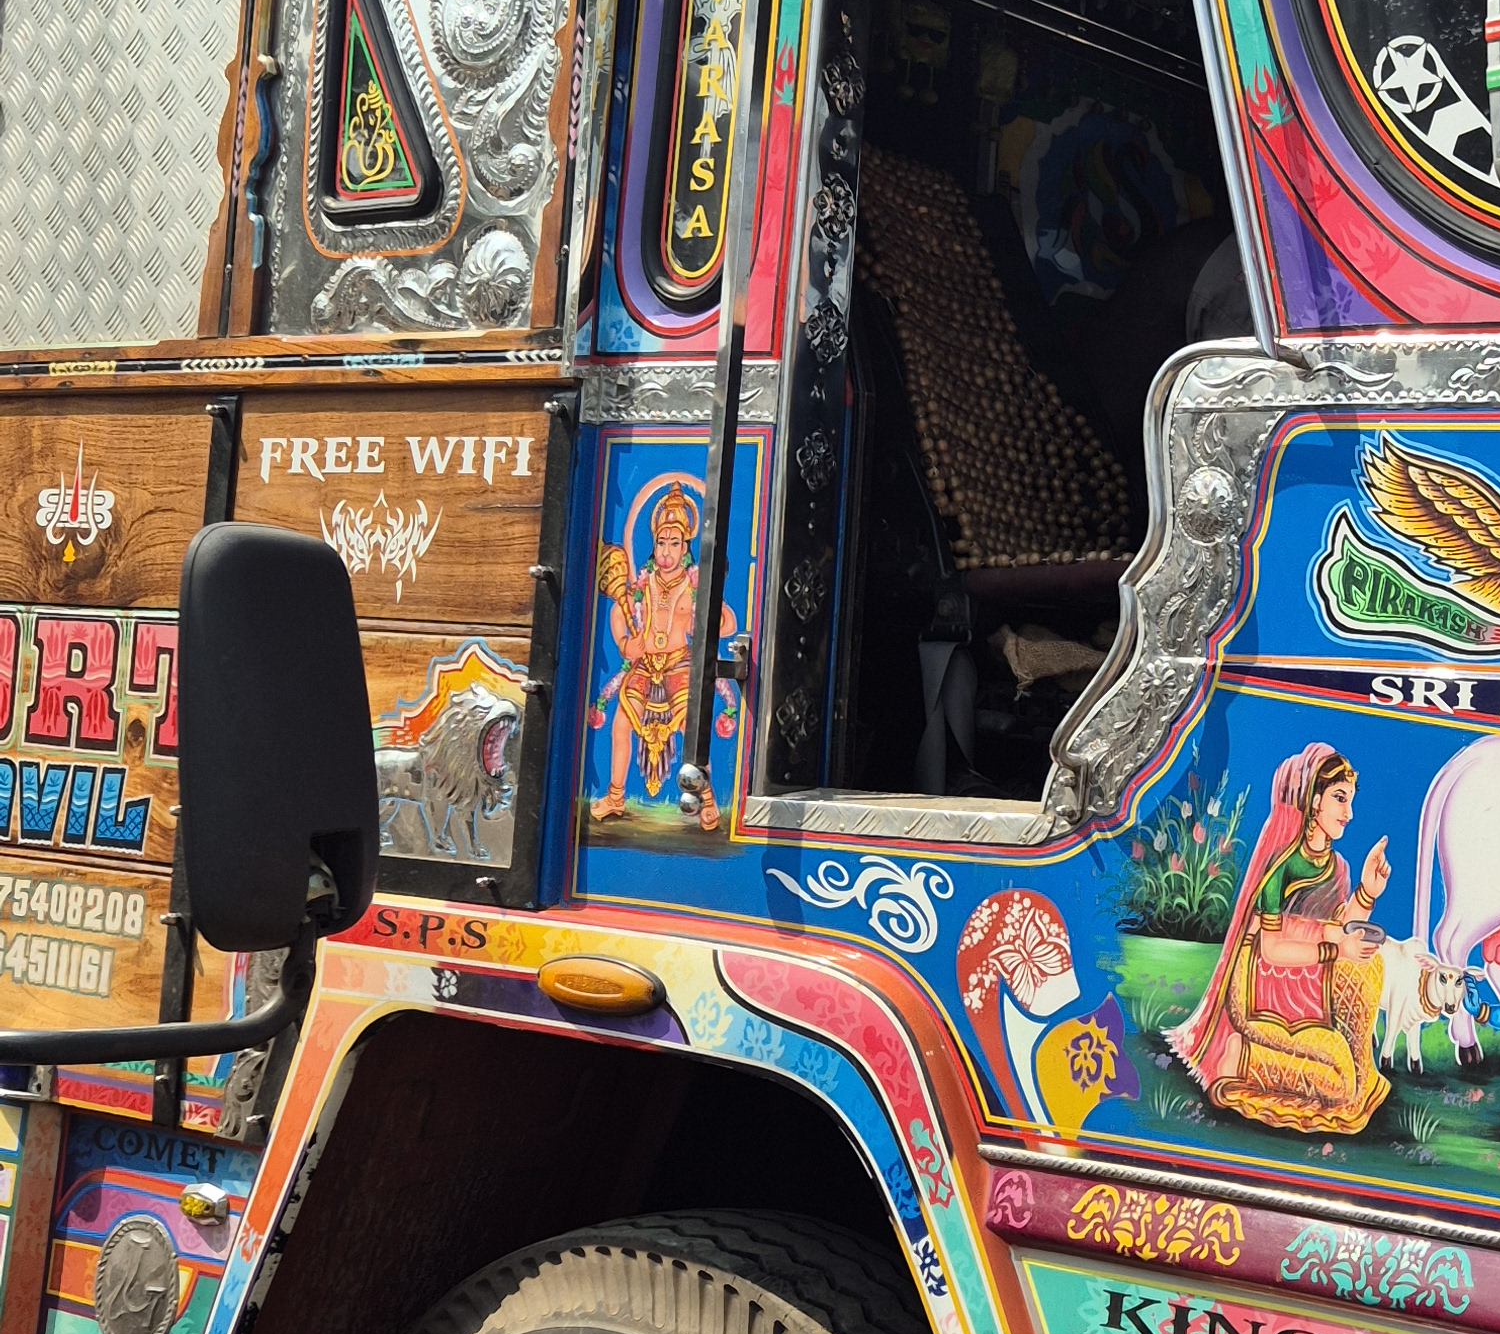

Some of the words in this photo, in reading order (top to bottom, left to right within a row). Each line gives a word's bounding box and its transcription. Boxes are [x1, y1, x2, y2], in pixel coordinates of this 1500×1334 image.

[259, 435, 386, 485] FREE
[408, 435, 533, 485] WIFI
[1341, 552, 1487, 641] PIRAKASH
[0, 615, 180, 759] RT
[1368, 675, 1477, 716] SRI
[0, 759, 152, 857] VIL
[372, 910, 490, 950] S.P.S
[0, 929, 113, 996] 4511161
[93, 1124, 226, 1175] COMET
